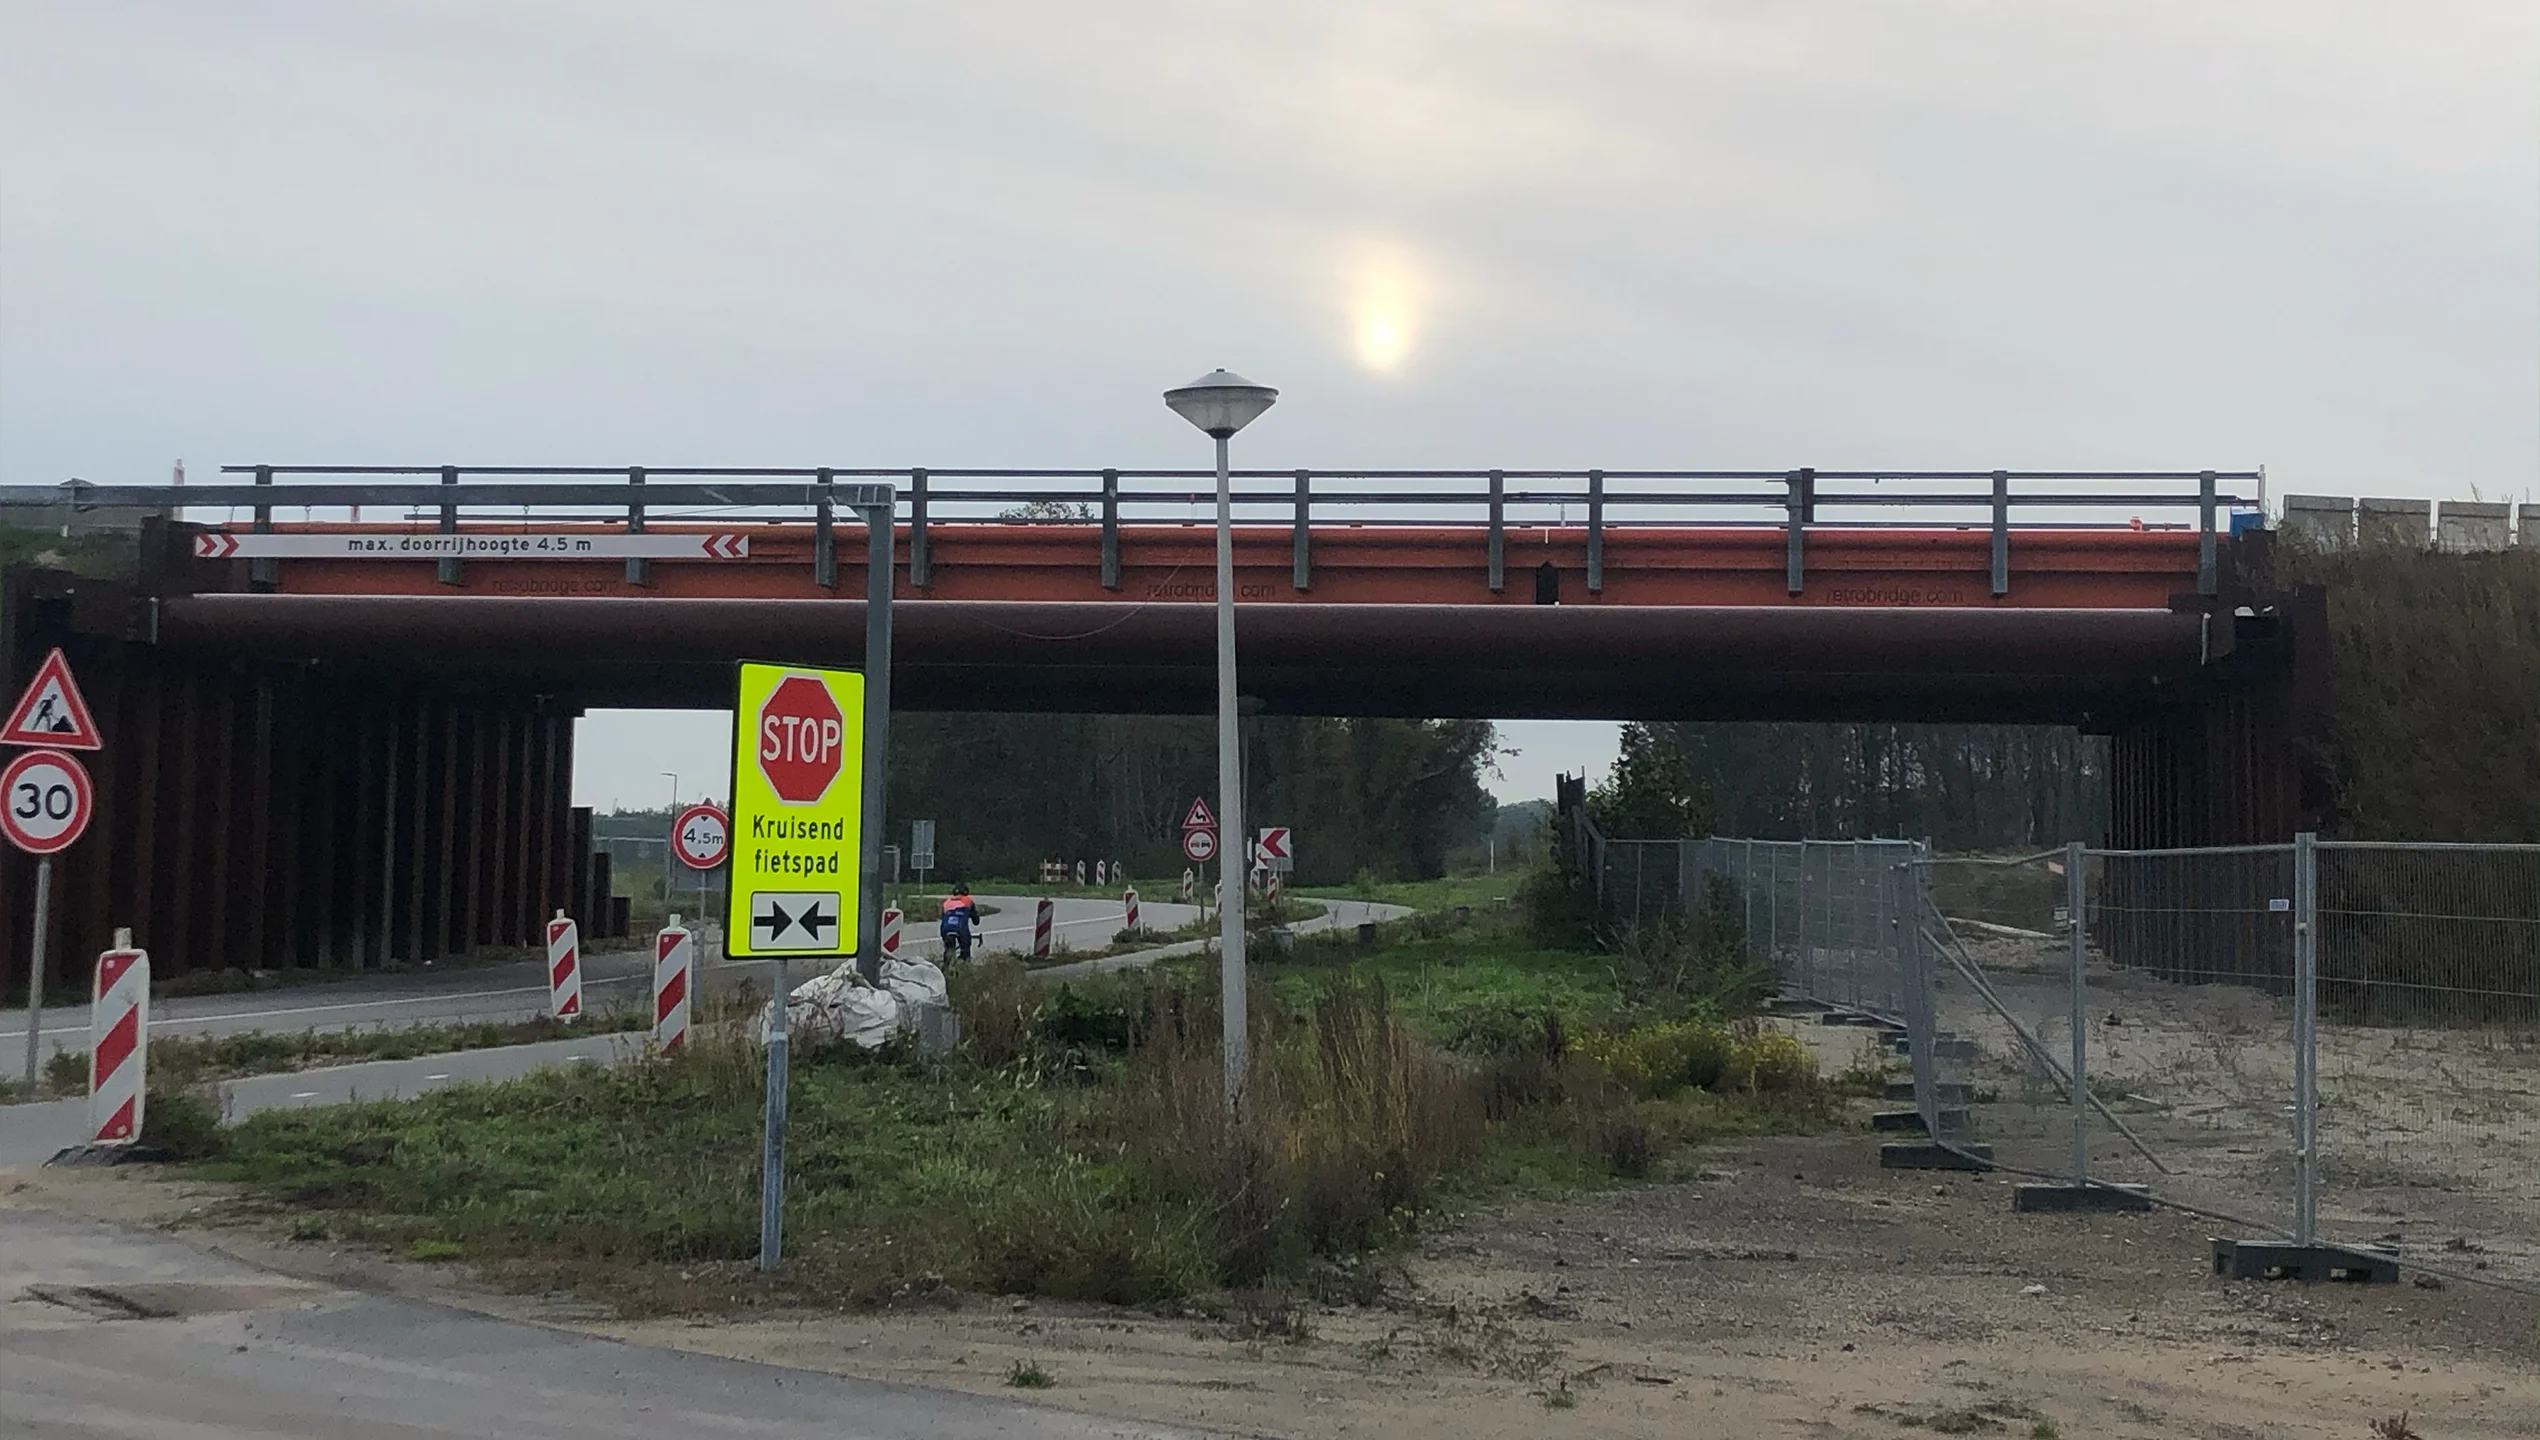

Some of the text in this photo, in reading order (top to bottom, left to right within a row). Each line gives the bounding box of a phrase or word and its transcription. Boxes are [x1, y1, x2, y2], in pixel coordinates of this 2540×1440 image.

[348, 537, 592, 555] max. doorrijhoogte 4.5 m
[1147, 580, 1275, 597] retrobrid.com
[762, 715, 840, 764] STOP
[16, 783, 73, 820] 30
[683, 828, 724, 845] 4.5m
[752, 814, 844, 840] Kruisend
[755, 848, 838, 878] fietspad
